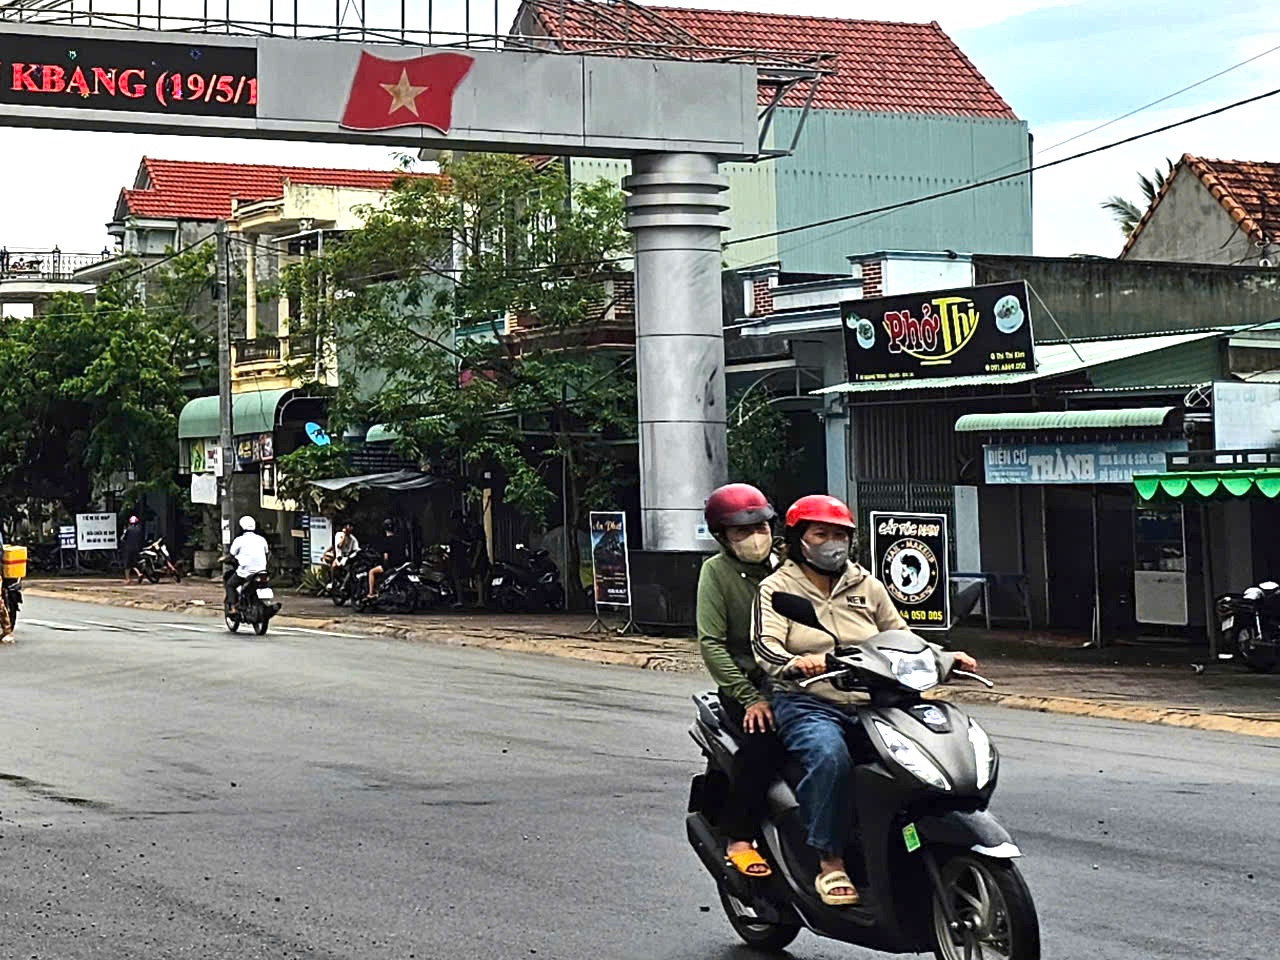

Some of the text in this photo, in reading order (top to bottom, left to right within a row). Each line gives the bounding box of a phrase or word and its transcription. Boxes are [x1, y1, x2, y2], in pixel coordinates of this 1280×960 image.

[10, 60, 146, 99] KBANG
[155, 70, 257, 107] (19/5/1
[884, 303, 940, 353] Phở
[906, 540, 935, 563] MAKEUP
